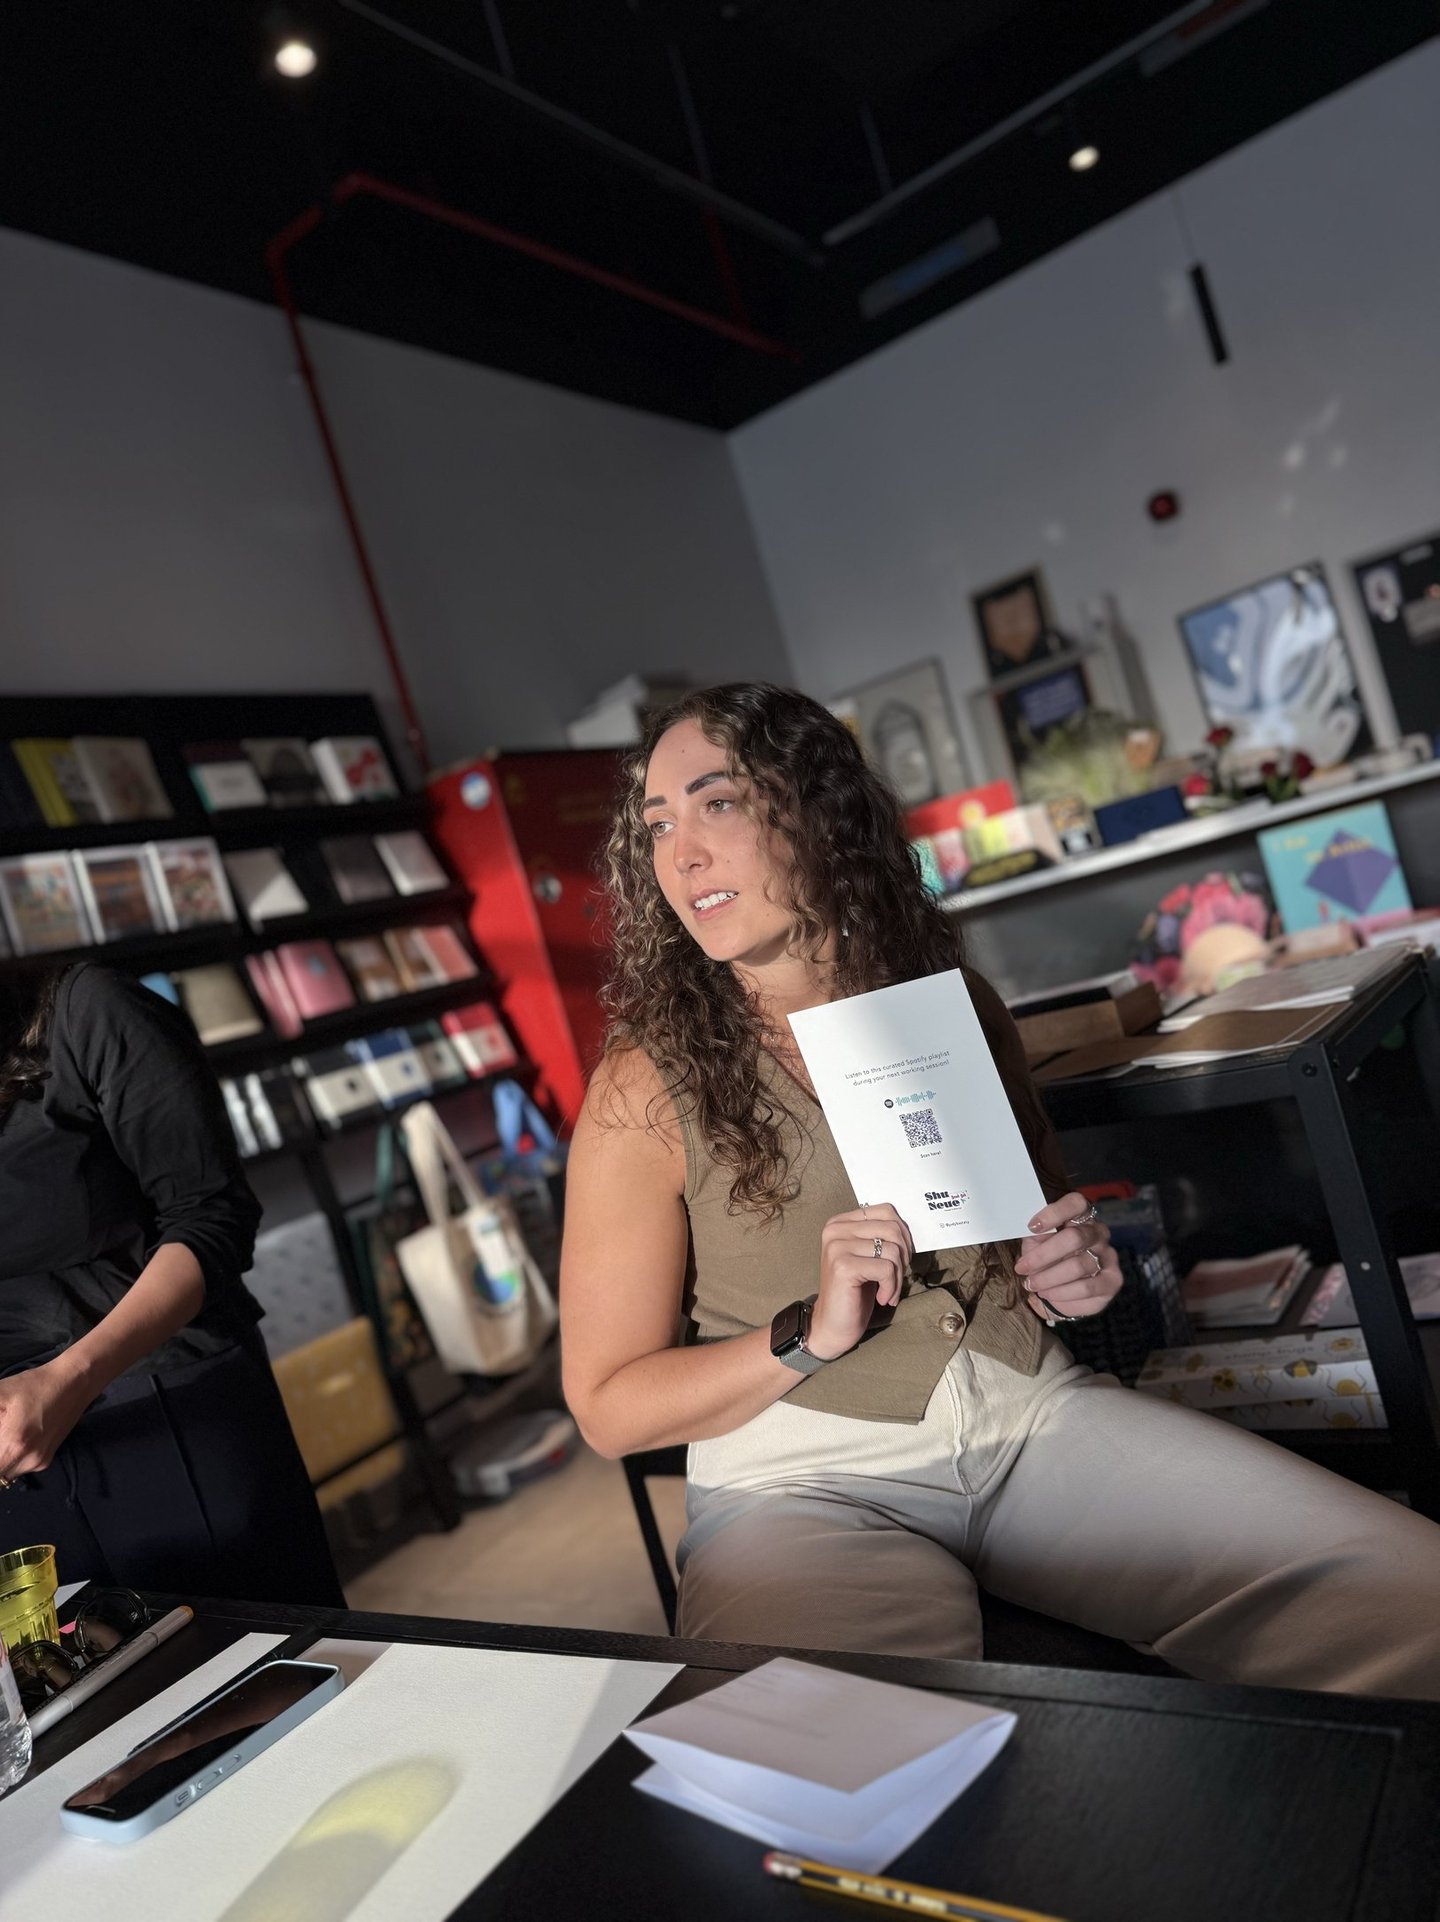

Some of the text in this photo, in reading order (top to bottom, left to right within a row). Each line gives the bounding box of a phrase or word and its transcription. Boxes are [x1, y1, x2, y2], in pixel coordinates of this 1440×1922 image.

[845, 1071, 862, 1080] Listen
[883, 1061, 905, 1070] curated
[905, 1056, 927, 1065] Spotify
[928, 1051, 950, 1060] playlist
[853, 1059, 950, 1086] during your next working session!
[924, 1191, 950, 1201] Shu
[928, 1200, 960, 1210] Neue
